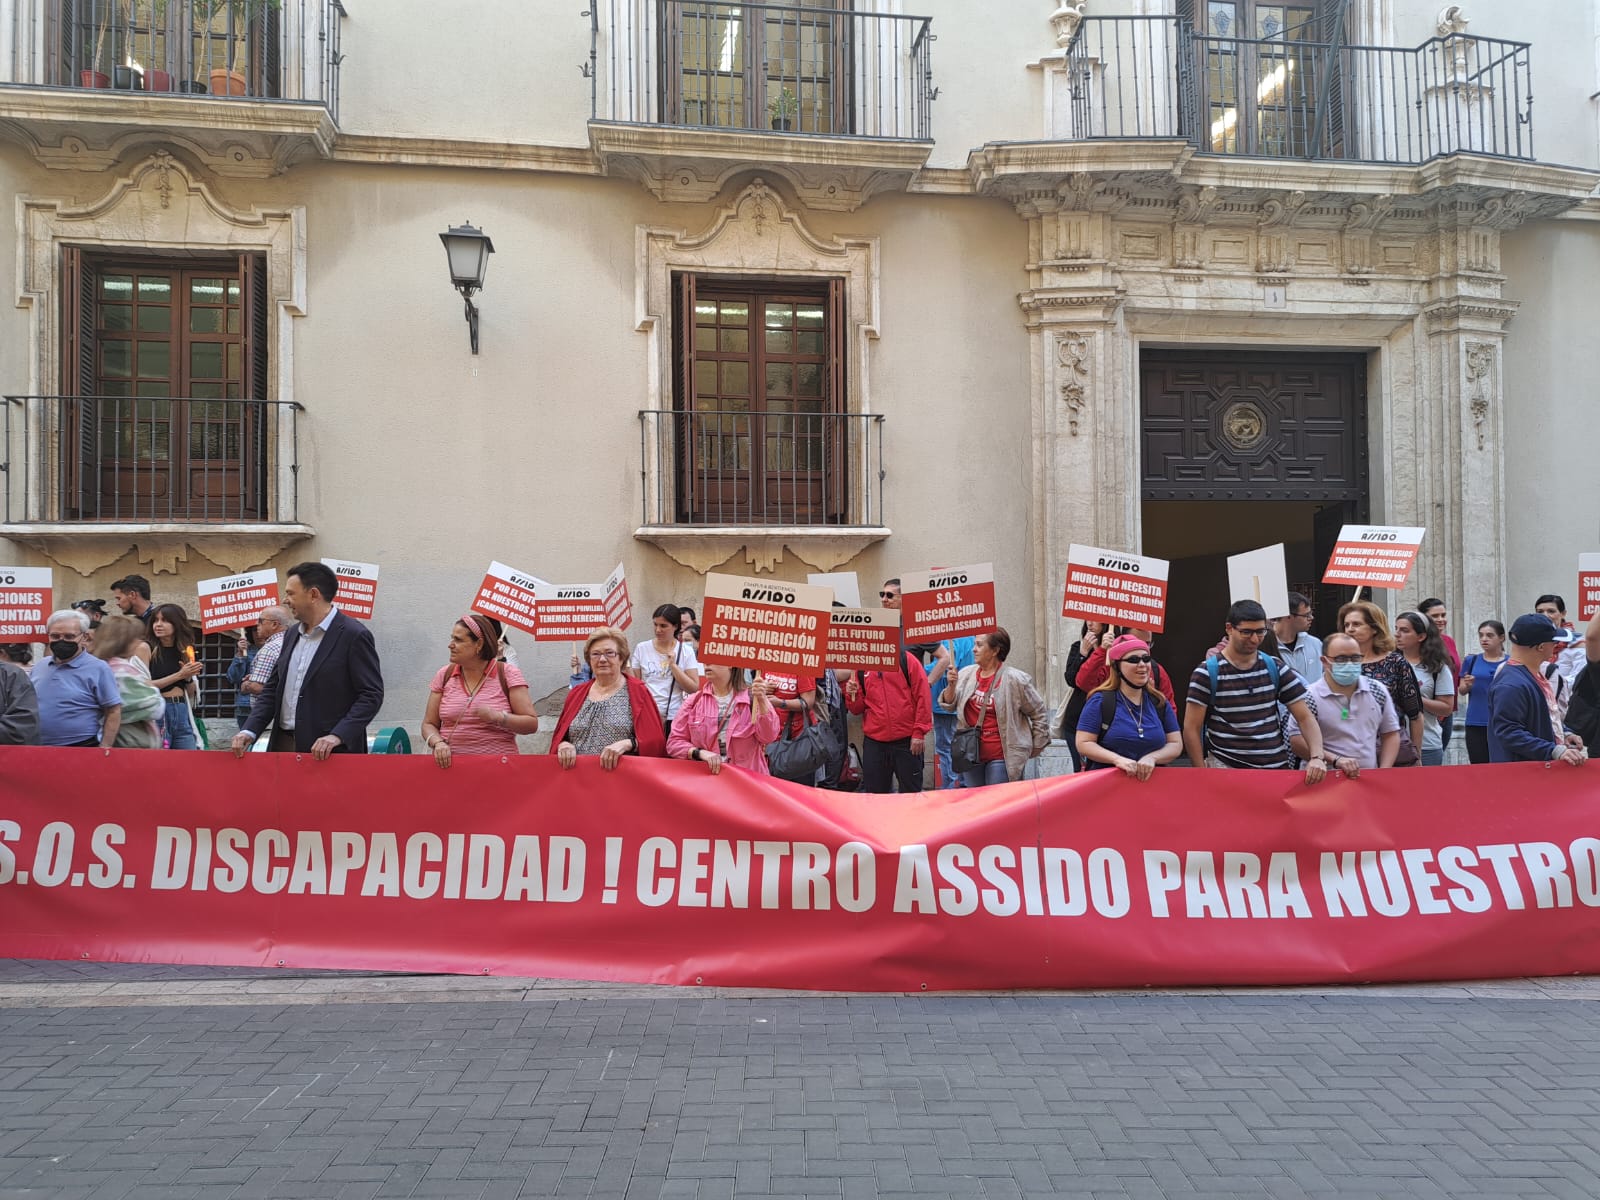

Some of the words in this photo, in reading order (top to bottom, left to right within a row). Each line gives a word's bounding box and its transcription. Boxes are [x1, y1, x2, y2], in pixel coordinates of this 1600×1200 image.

[1098, 558, 1140, 573] ASSIDO
[221, 579, 254, 590] ASSIDO
[510, 575, 535, 590] ASSID
[929, 575, 968, 588] ASSIDO
[1071, 571, 1108, 587] MURCIA
[1109, 578, 1120, 589] LO
[1121, 580, 1162, 597] NECESITA
[211, 595, 227, 605] POR
[228, 594, 236, 602] EL
[237, 588, 267, 600] FUTURO
[494, 582, 510, 594] POR
[510, 588, 519, 598] EL
[557, 590, 591, 598] ASSIDO
[742, 588, 795, 604] ASSIDO
[936, 590, 962, 604] S.O.S.
[1067, 583, 1107, 599] NUESTROS
[1108, 590, 1130, 603] HIJOS
[1131, 594, 1163, 609] TAMBIÉN
[204, 609, 214, 618] DE
[214, 601, 254, 616] NUESTROS
[255, 597, 277, 608] HIJOS
[481, 588, 492, 598] DE
[491, 592, 530, 614] NUESTROS
[538, 605, 546, 613] NO
[508, 612, 535, 628] ASSIDO
[539, 614, 571, 623] TENEMOS
[715, 604, 796, 628] PREVENCIÓN
[798, 615, 817, 631] NO
[832, 614, 872, 624] ASSIDO
[915, 602, 985, 622] DISCAPACIDAD
[1064, 600, 1117, 617] ¡RESIDENCIA
[1117, 608, 1148, 623] ASSIDO
[1149, 614, 1162, 625] YA!
[0, 624, 32, 635] SSIDO
[33, 624, 48, 634] YA
[839, 628, 848, 638] EL
[850, 629, 885, 640] FUTURO
[906, 623, 954, 638] ¡RESIDENCIA
[954, 619, 982, 631] ASSIDO
[982, 616, 995, 627] YA!
[712, 623, 728, 639] ES
[730, 626, 816, 651] PROHIBICIÓN
[704, 642, 756, 660] ¡CAMPUS
[758, 648, 799, 665] ASSIDO
[802, 653, 820, 668] YA!
[870, 642, 896, 653] HIJOS
[849, 654, 880, 665] ASSIDO
[881, 656, 895, 666] YA!
[0, 819, 136, 889] S.O.S.
[150, 825, 587, 903] DISCAPACIDAD
[601, 836, 623, 905] !
[636, 836, 876, 913] CENTRO
[892, 843, 1130, 919] ASSIDO
[1142, 849, 1312, 919] PARA
[1319, 837, 1600, 918] NUESTRO
